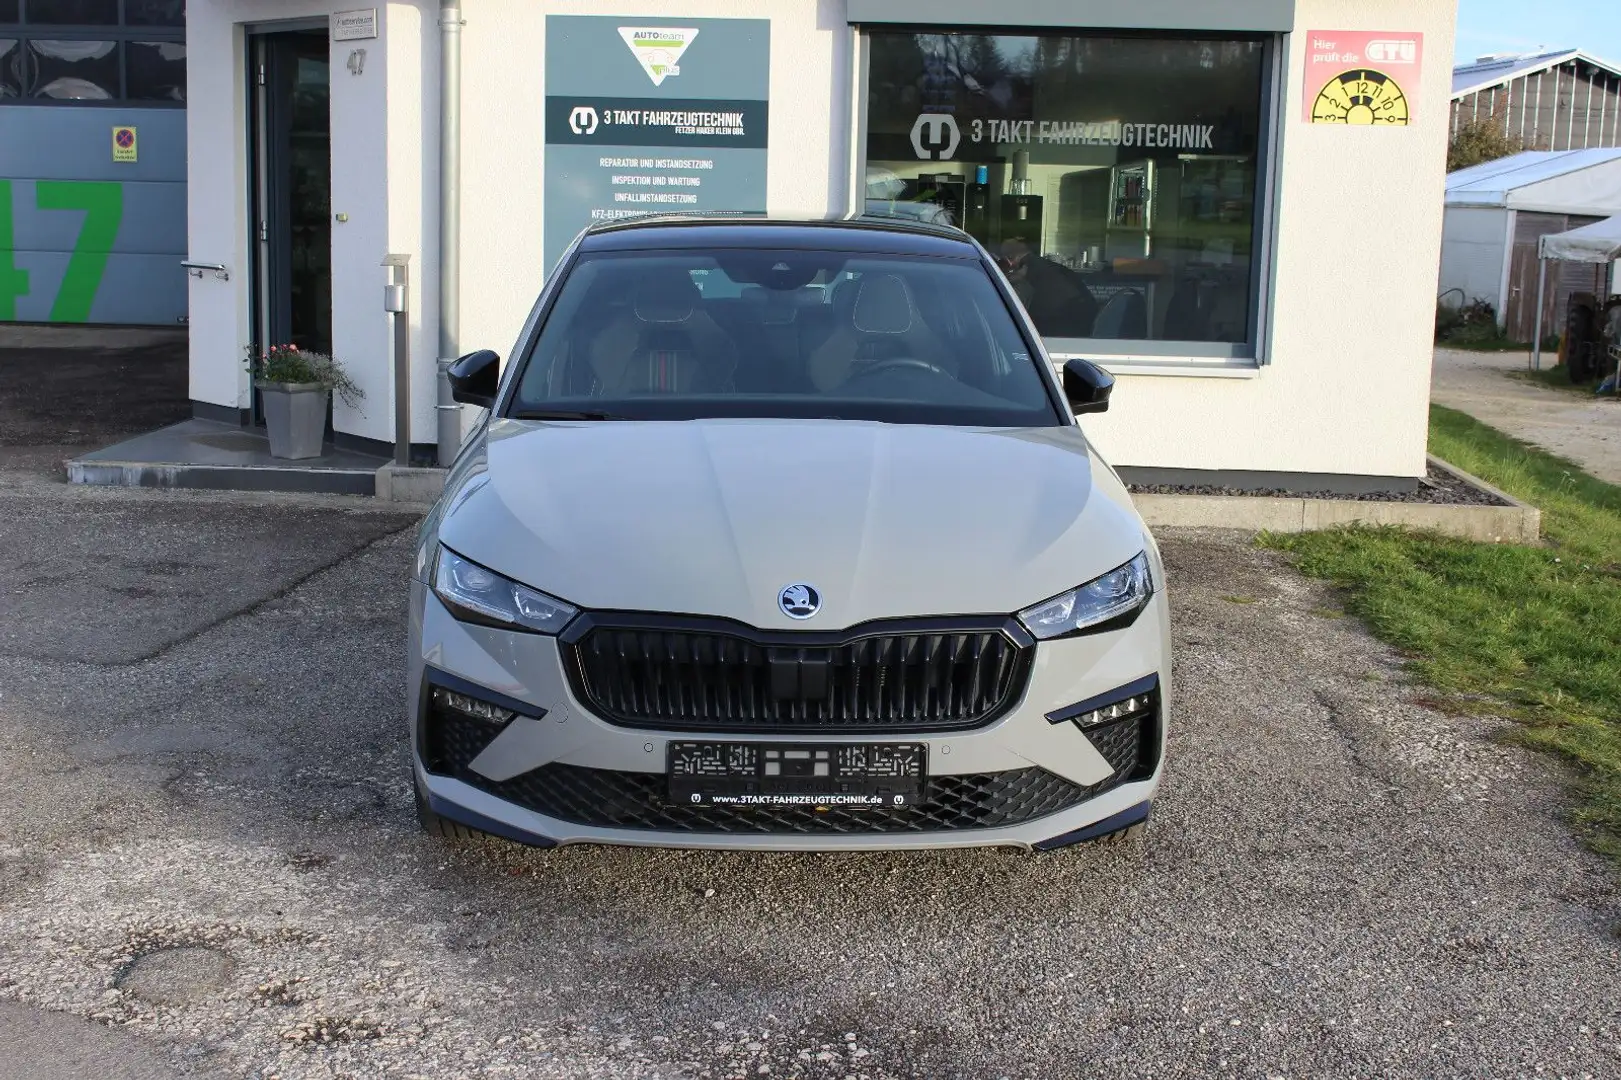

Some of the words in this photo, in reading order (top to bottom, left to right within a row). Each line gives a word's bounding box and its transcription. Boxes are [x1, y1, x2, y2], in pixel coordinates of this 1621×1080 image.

[1313, 39, 1336, 50] Hier
[1313, 52, 1340, 64] prüft
[1341, 53, 1359, 64] die
[1356, 82, 1369, 94] 12
[604, 110, 611, 124] 3
[613, 110, 640, 125] TAKT
[643, 111, 744, 127] FAHRZEUGTECHNIK
[675, 126, 696, 135] FETZER
[716, 127, 732, 135] KLEIN
[971, 119, 983, 143] 3
[988, 119, 1034, 144] TAKT
[1039, 120, 1214, 149] FAHRZEUGTECHNIK
[600, 158, 639, 168] REPARATUR
[640, 159, 654, 168] UND
[655, 159, 713, 169] INSTANDSETZUNG
[612, 175, 651, 186] INSPEKTION
[652, 177, 666, 186] UND
[667, 177, 701, 187] WARTUNG
[614, 193, 698, 204] UNFALLINSTANDSETZUNG
[712, 794, 883, 805] www.3TAKT-FAHRZEUGTECHNIK.de
